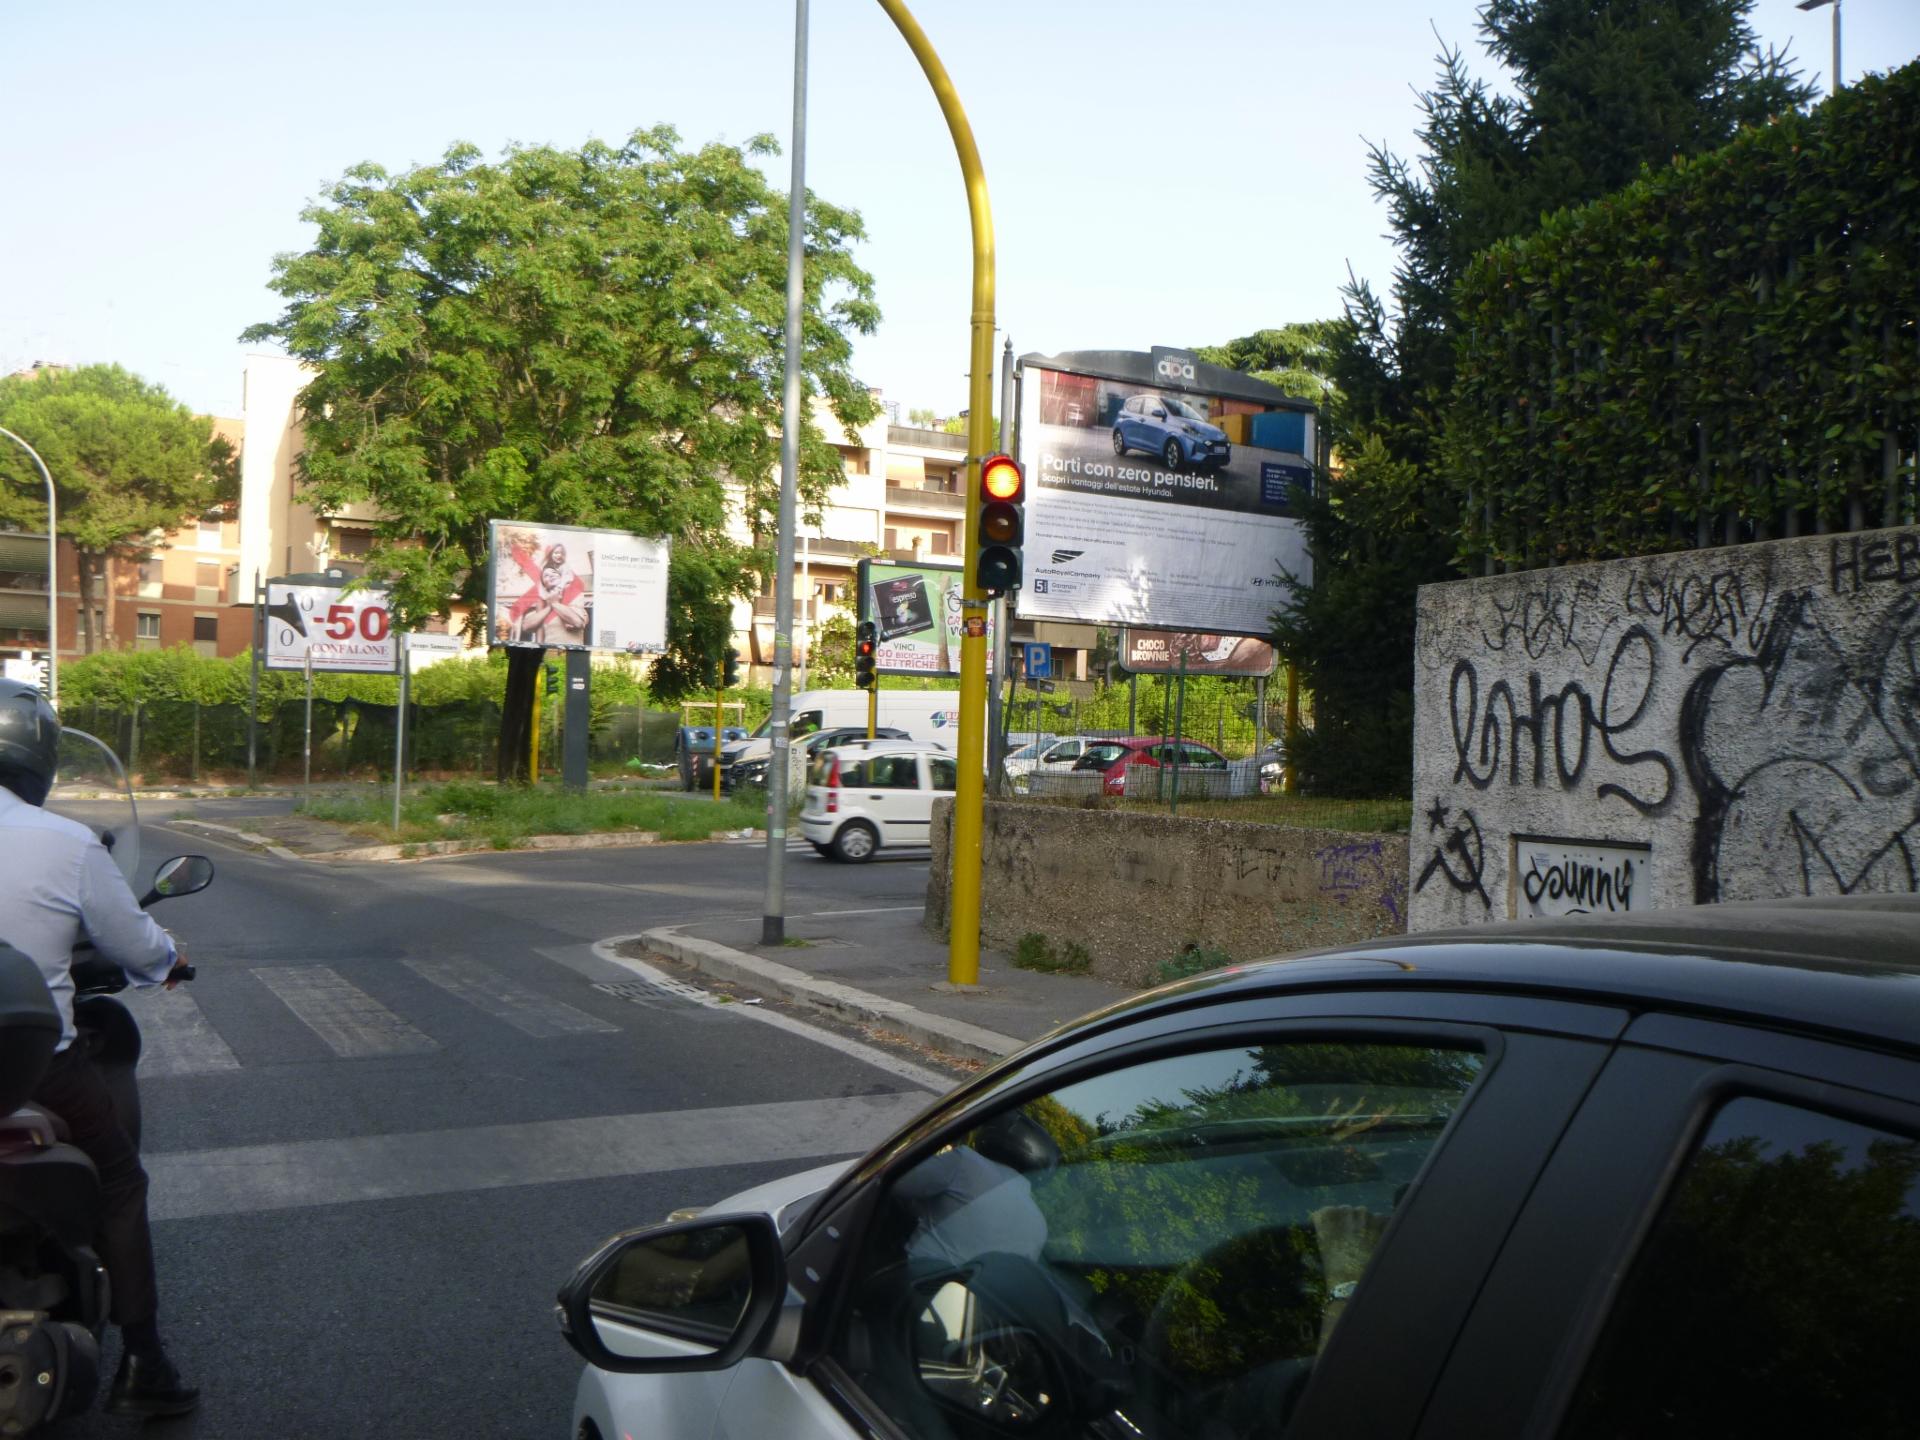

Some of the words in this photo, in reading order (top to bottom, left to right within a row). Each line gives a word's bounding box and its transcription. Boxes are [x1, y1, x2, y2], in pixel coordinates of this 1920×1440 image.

[1042, 453, 1081, 473] Parti
[1084, 463, 1114, 478] con
[1117, 466, 1151, 482] zero
[1154, 471, 1219, 492] pensieri.
[1041, 472, 1066, 485] Scopri
[1071, 478, 1104, 490] vantaggi
[893, 643, 916, 652] VINCI
[1137, 639, 1165, 651] CHOCO
[1030, 647, 1046, 675] P
[1131, 650, 1171, 662] BROWNIE
